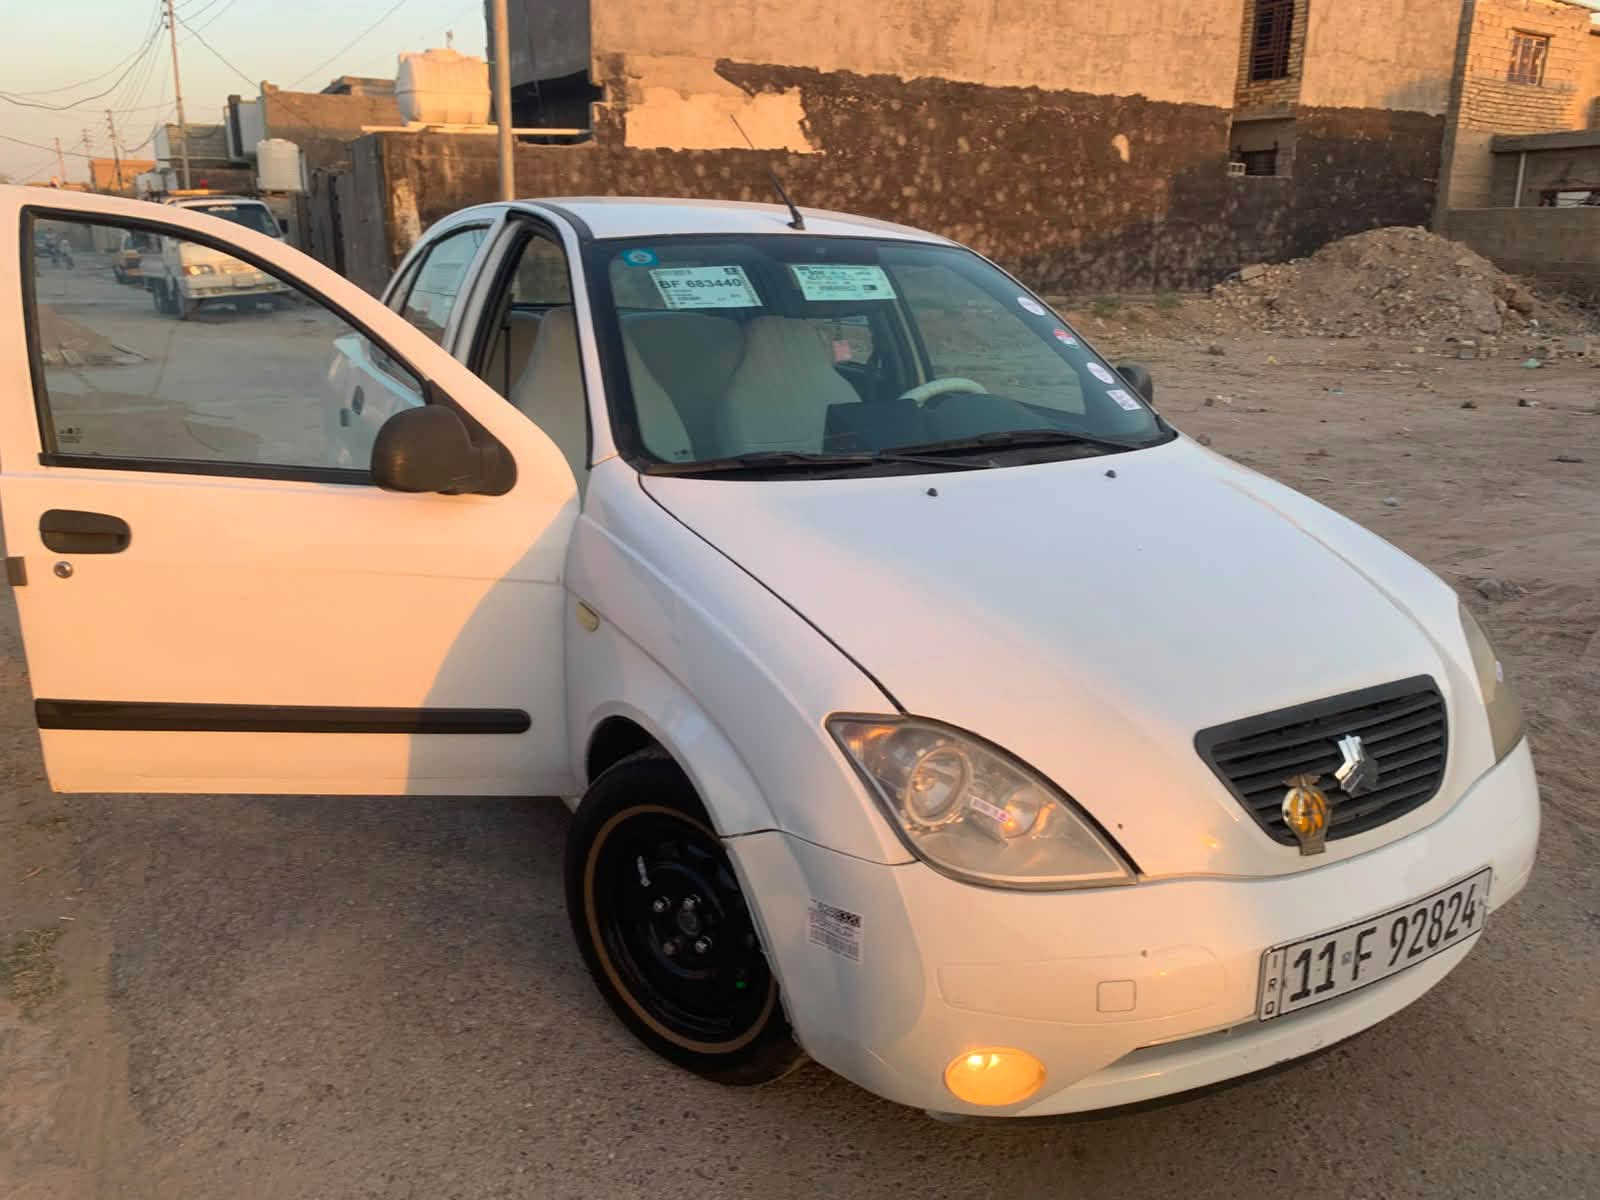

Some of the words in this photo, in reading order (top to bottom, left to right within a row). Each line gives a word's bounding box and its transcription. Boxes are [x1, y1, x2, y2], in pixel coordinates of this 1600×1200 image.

[1289, 941, 1337, 1002] 11
[1351, 926, 1377, 981] F
[1387, 883, 1477, 967] 92824
